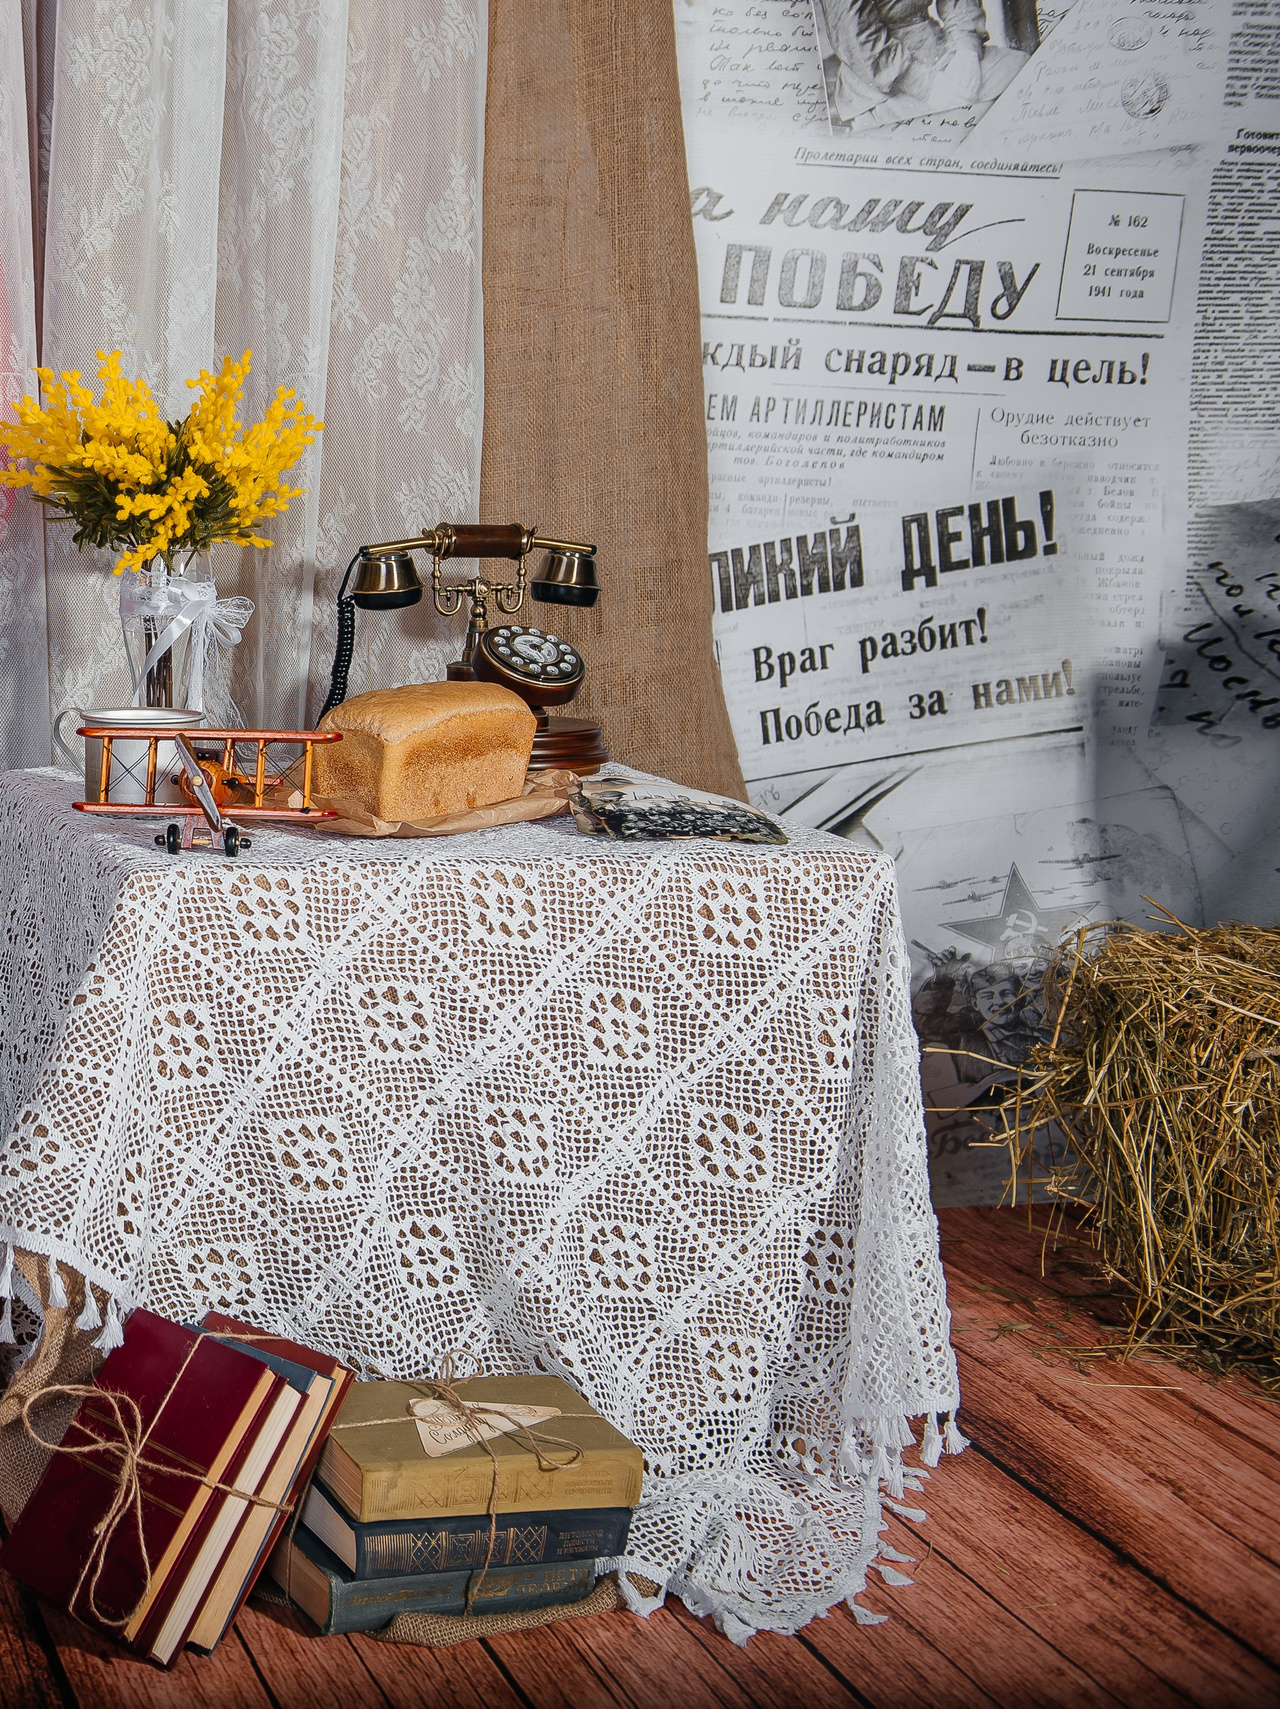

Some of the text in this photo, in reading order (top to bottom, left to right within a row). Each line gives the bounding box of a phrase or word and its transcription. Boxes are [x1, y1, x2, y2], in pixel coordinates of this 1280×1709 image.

[794, 147, 1064, 174] Пролетарии всех стран, соединяйтесь!
[1128, 215, 1148, 228] 162
[1087, 242, 1160, 259] Воскресенье
[1083, 264, 1155, 281] 21 сентября
[720, 243, 1042, 328] ПОБЕДУ
[1088, 285, 1144, 299] 1941 года
[1048, 352, 1150, 388] цель!
[749, 395, 946, 433] АРТИЛЛЕРИСТАМ
[991, 407, 1152, 431] Орудие действует
[837, 435, 947, 448] политработников
[1021, 430, 1119, 448] безотказно
[901, 490, 1058, 592] ДЕНЬ!
[752, 606, 989, 689] Враг разбит!
[760, 657, 1076, 746] Победа за нами!
